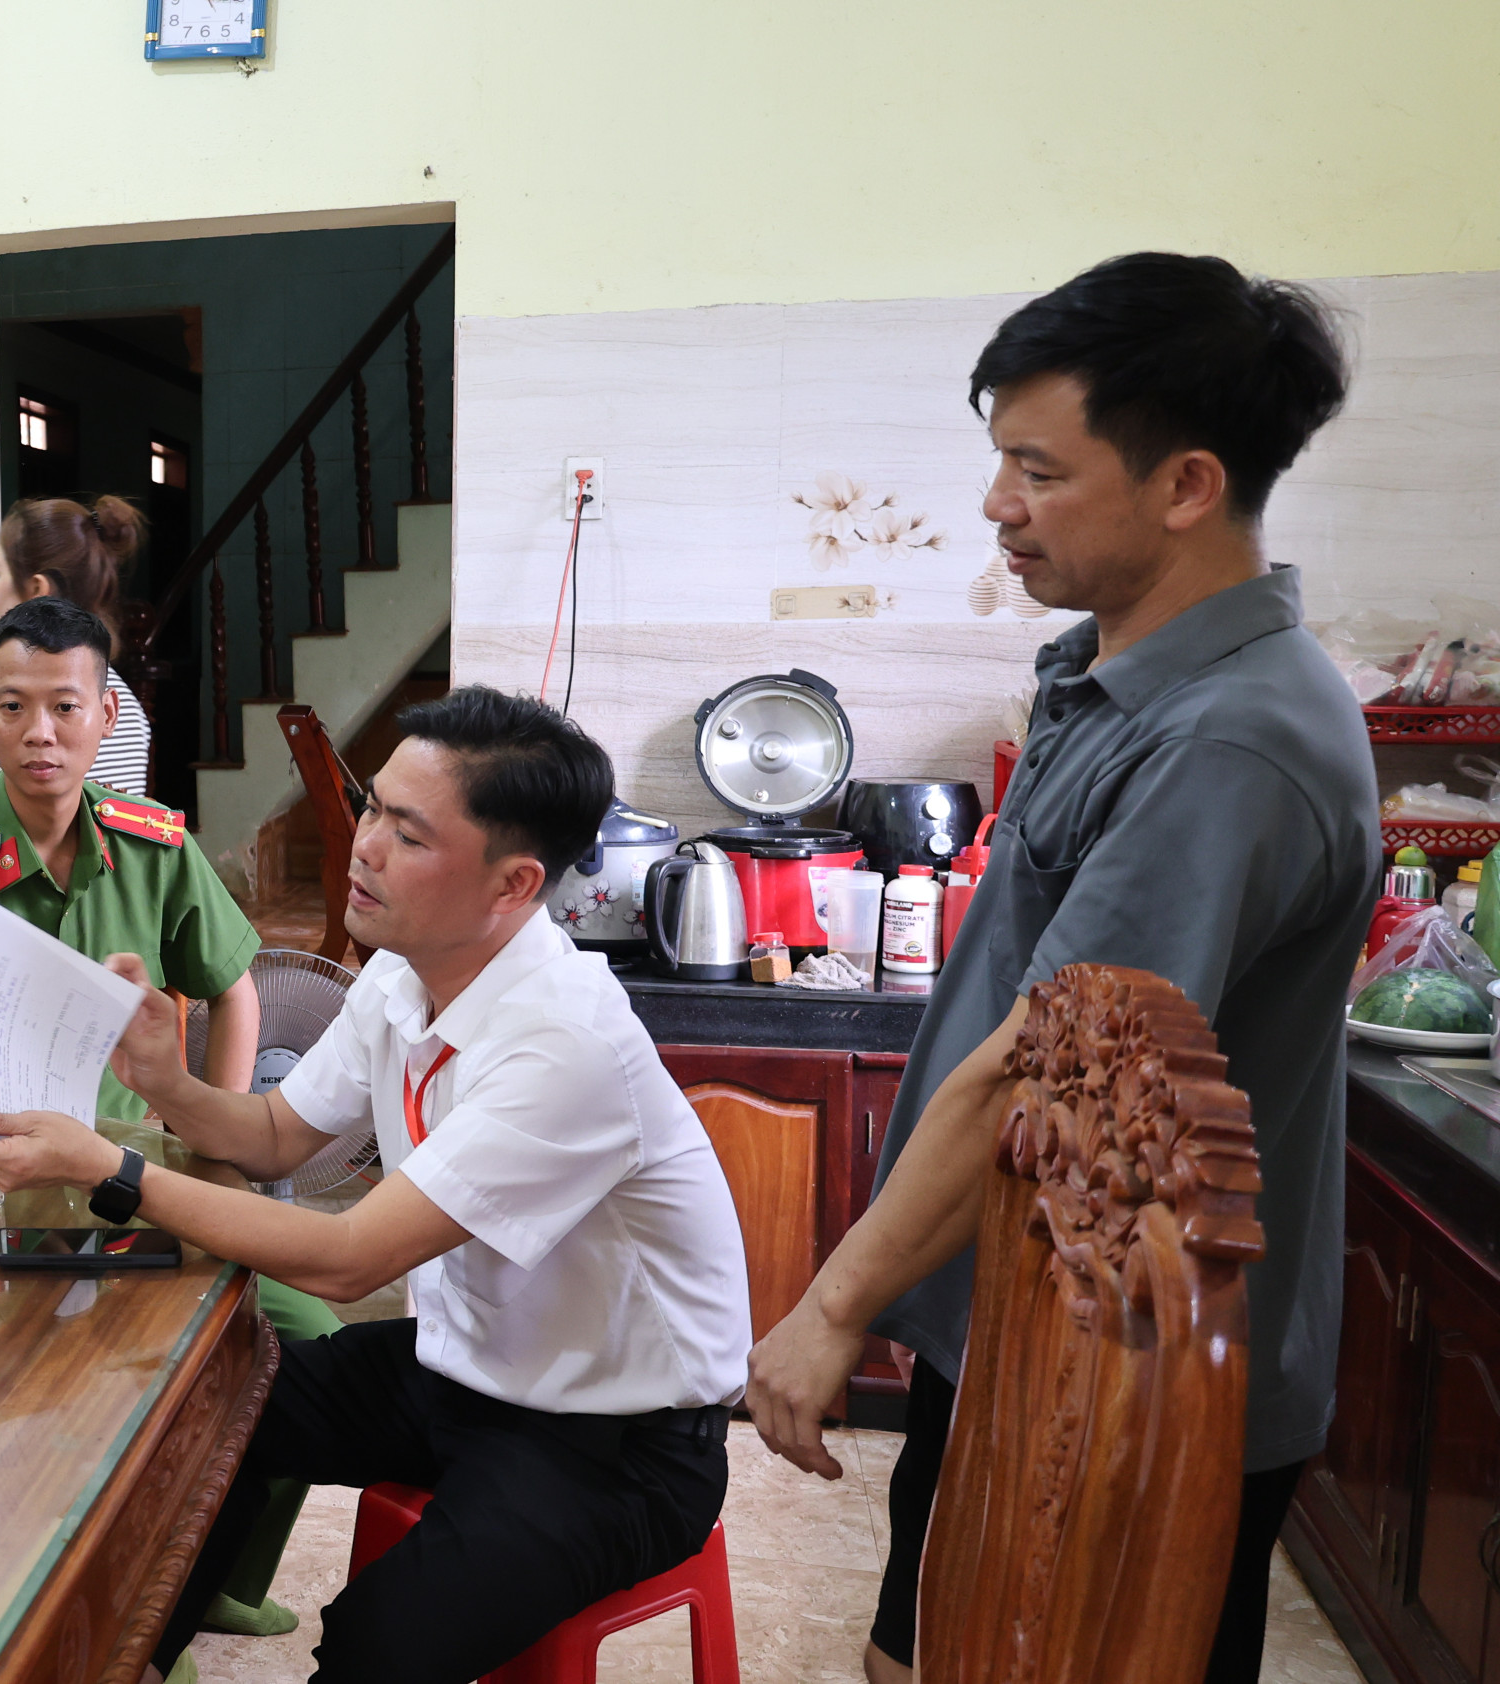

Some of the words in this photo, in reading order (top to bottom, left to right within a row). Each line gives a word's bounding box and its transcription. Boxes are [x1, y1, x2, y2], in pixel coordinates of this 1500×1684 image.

[169, 15, 180, 26] 8
[234, 13, 244, 24] 4
[183, 26, 193, 38] 7
[200, 25, 210, 37] 6
[220, 25, 231, 37] 5
